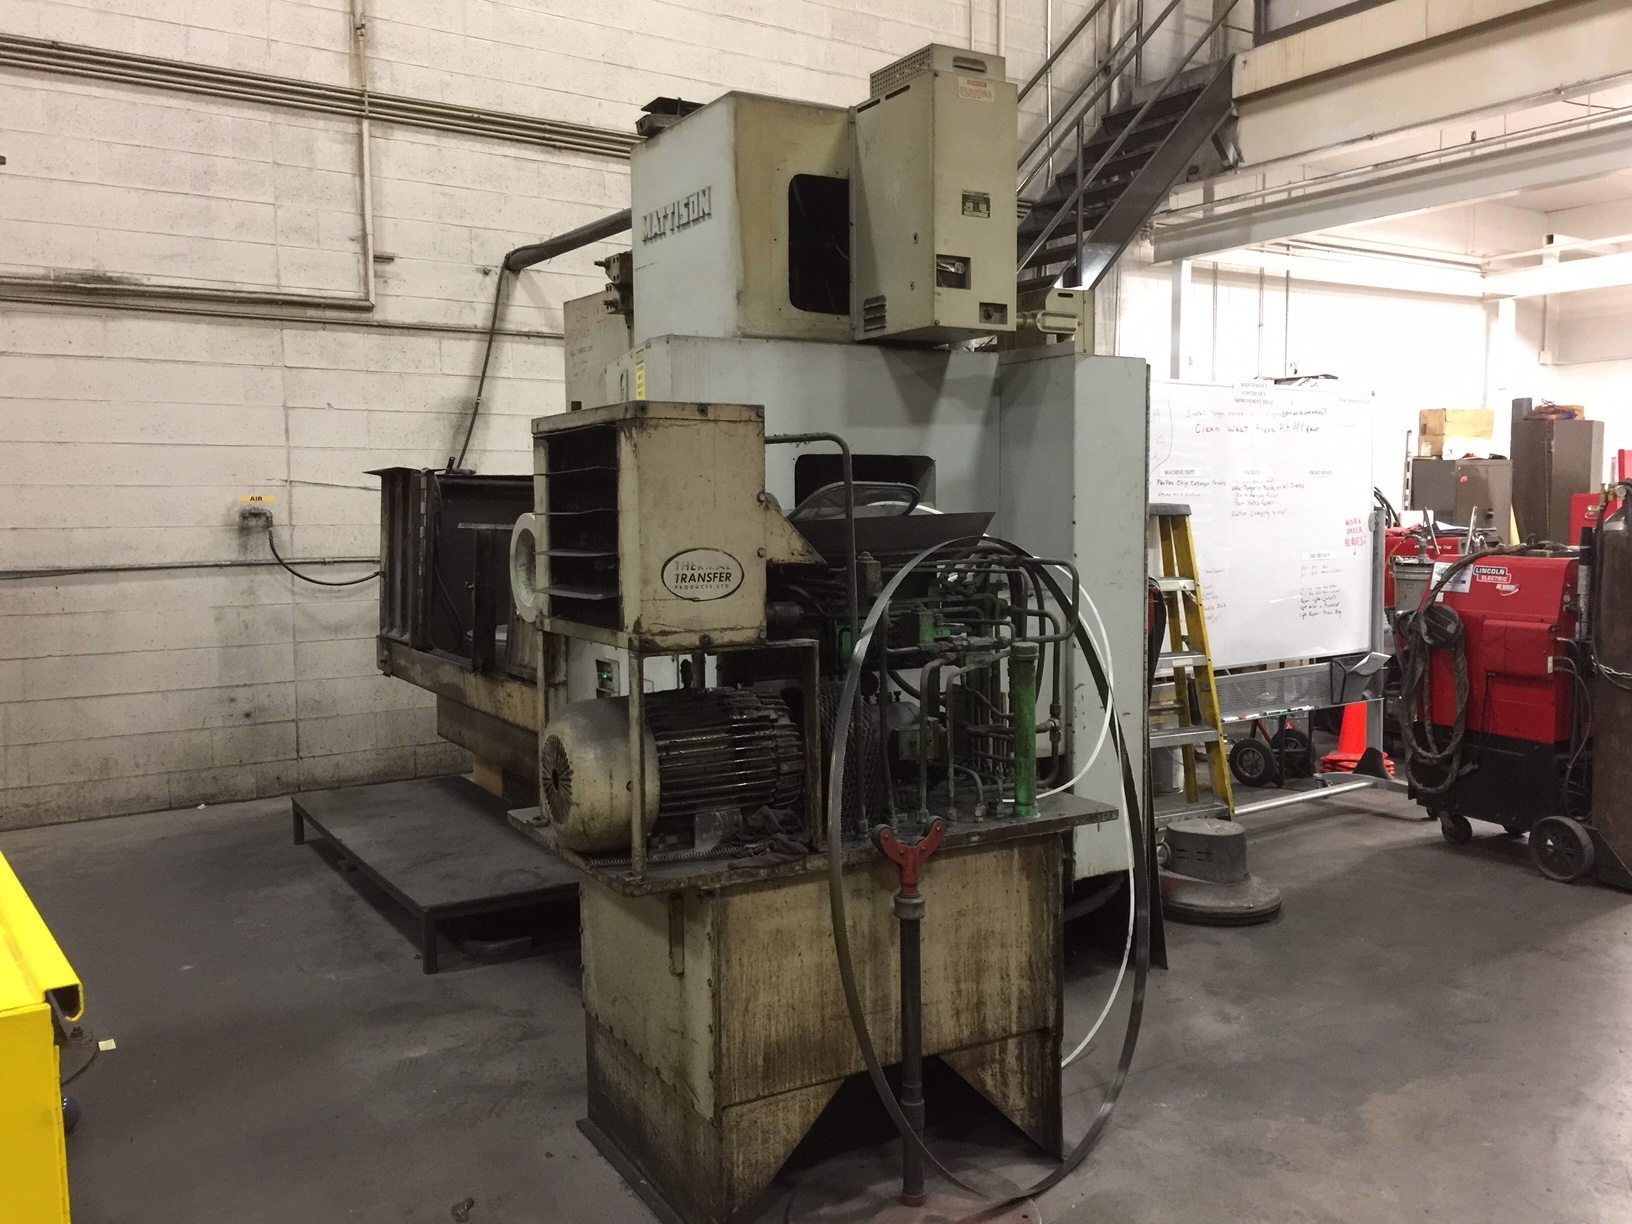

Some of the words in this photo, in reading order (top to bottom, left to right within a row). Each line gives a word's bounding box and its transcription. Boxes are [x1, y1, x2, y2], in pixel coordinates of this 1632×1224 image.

[641, 185, 712, 244] MATTISON
[1194, 422, 1220, 434] Clean
[674, 571, 732, 583] TRANSFER
[1475, 567, 1506, 575] LINCOLN
